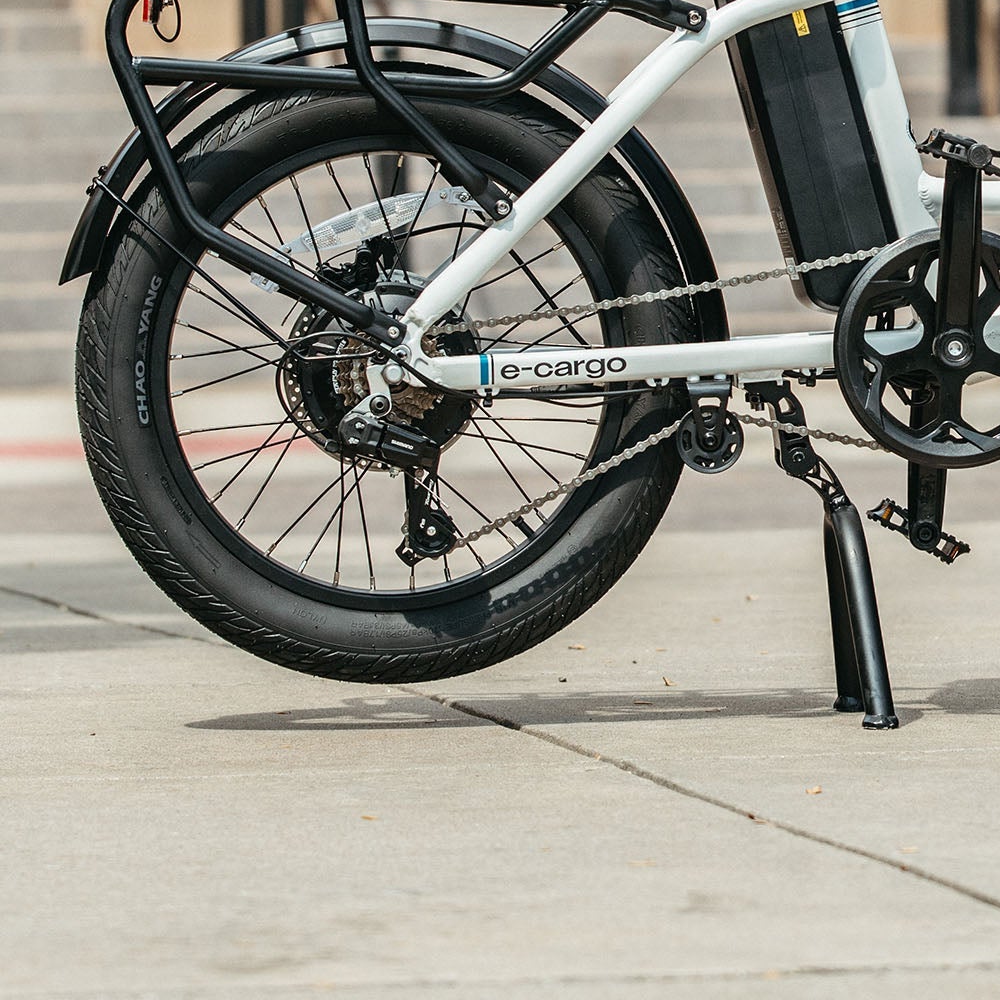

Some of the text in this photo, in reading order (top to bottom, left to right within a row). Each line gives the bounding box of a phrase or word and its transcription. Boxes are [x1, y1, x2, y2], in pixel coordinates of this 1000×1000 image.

[135, 275, 162, 424] CHAO YANG
[500, 356, 627, 379] e-cargo
